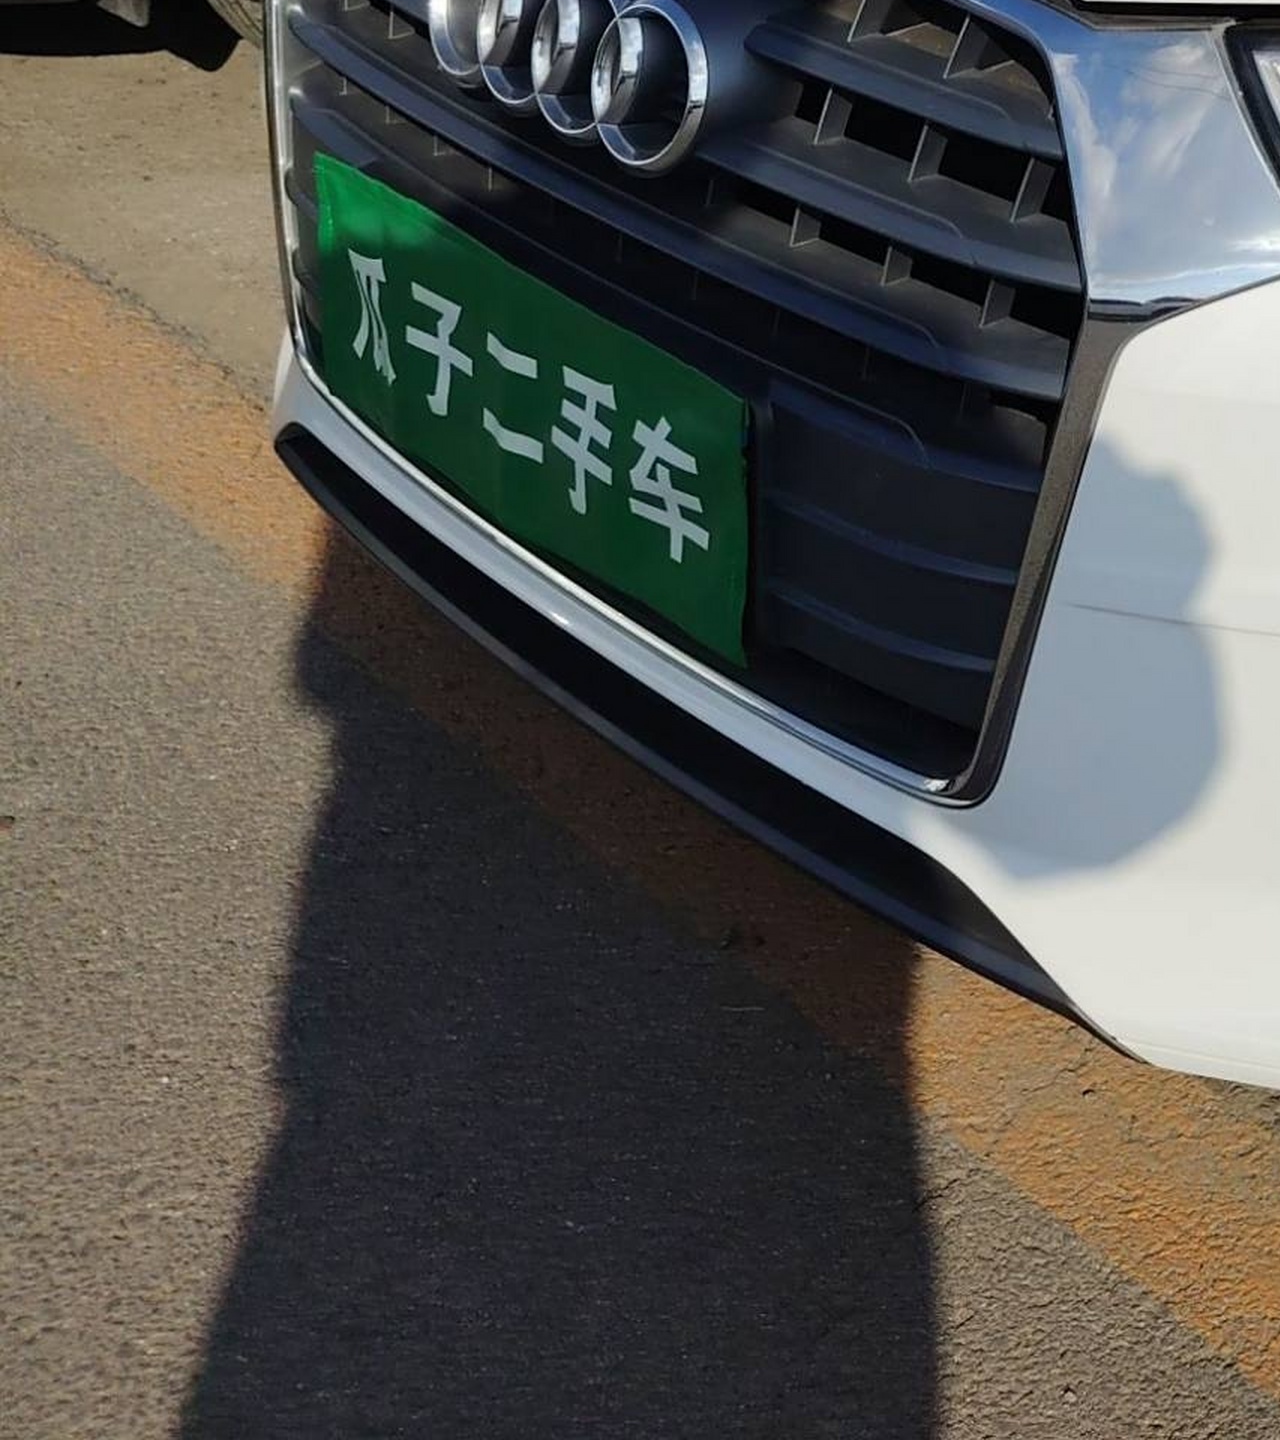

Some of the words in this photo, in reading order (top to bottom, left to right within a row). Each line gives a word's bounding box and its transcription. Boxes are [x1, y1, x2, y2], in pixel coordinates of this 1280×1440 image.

[348, 246, 711, 564] 瓜子二手车
